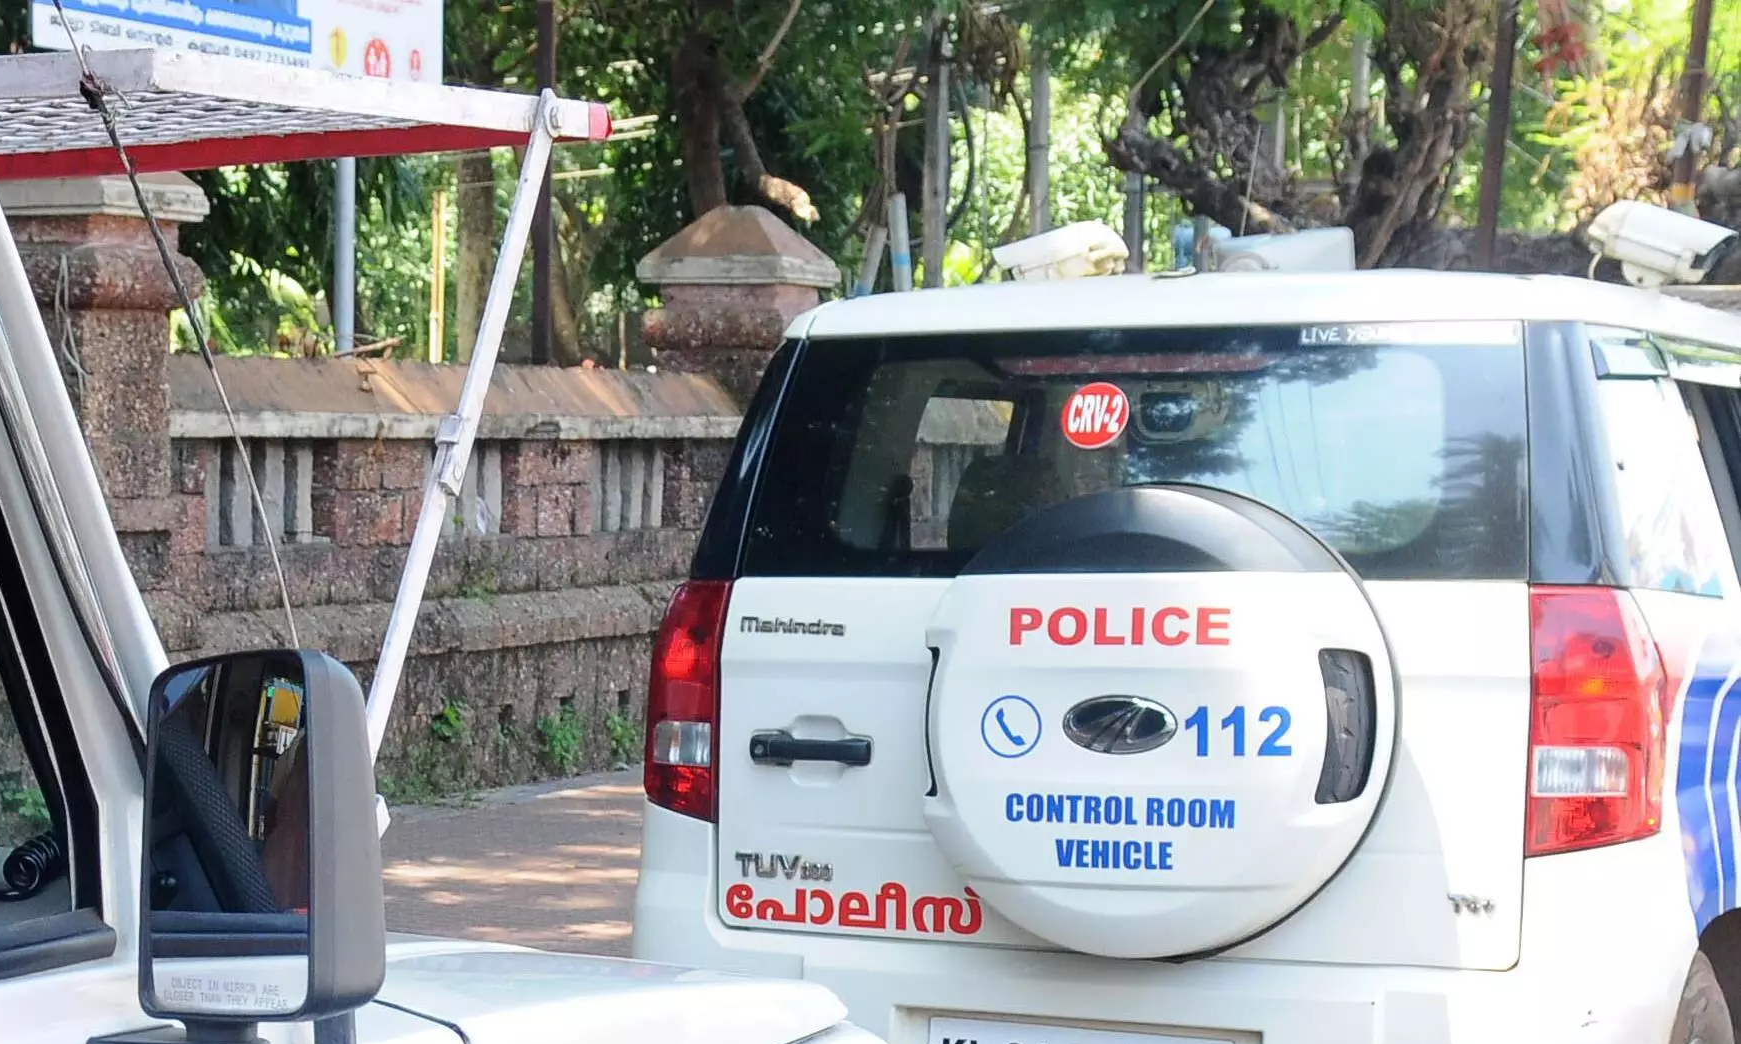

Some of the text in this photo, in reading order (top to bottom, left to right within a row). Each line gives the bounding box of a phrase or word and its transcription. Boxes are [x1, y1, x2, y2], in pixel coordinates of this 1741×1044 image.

[1301, 326, 1341, 344] LIVE
[1067, 394, 1123, 433] CRV-2
[740, 615, 846, 637] Mahindra
[1010, 606, 1231, 647] POLICE
[1184, 705, 1293, 758] 112
[1005, 793, 1236, 829] CONTROL ROOM
[1055, 839, 1173, 872] VEHICLE
[726, 881, 983, 936] പോലീസ്
[200, 991, 222, 1004] THAN
[226, 993, 248, 1006] THEY
[208, 979, 220, 990] IN
[223, 980, 257, 994] MIRROR
